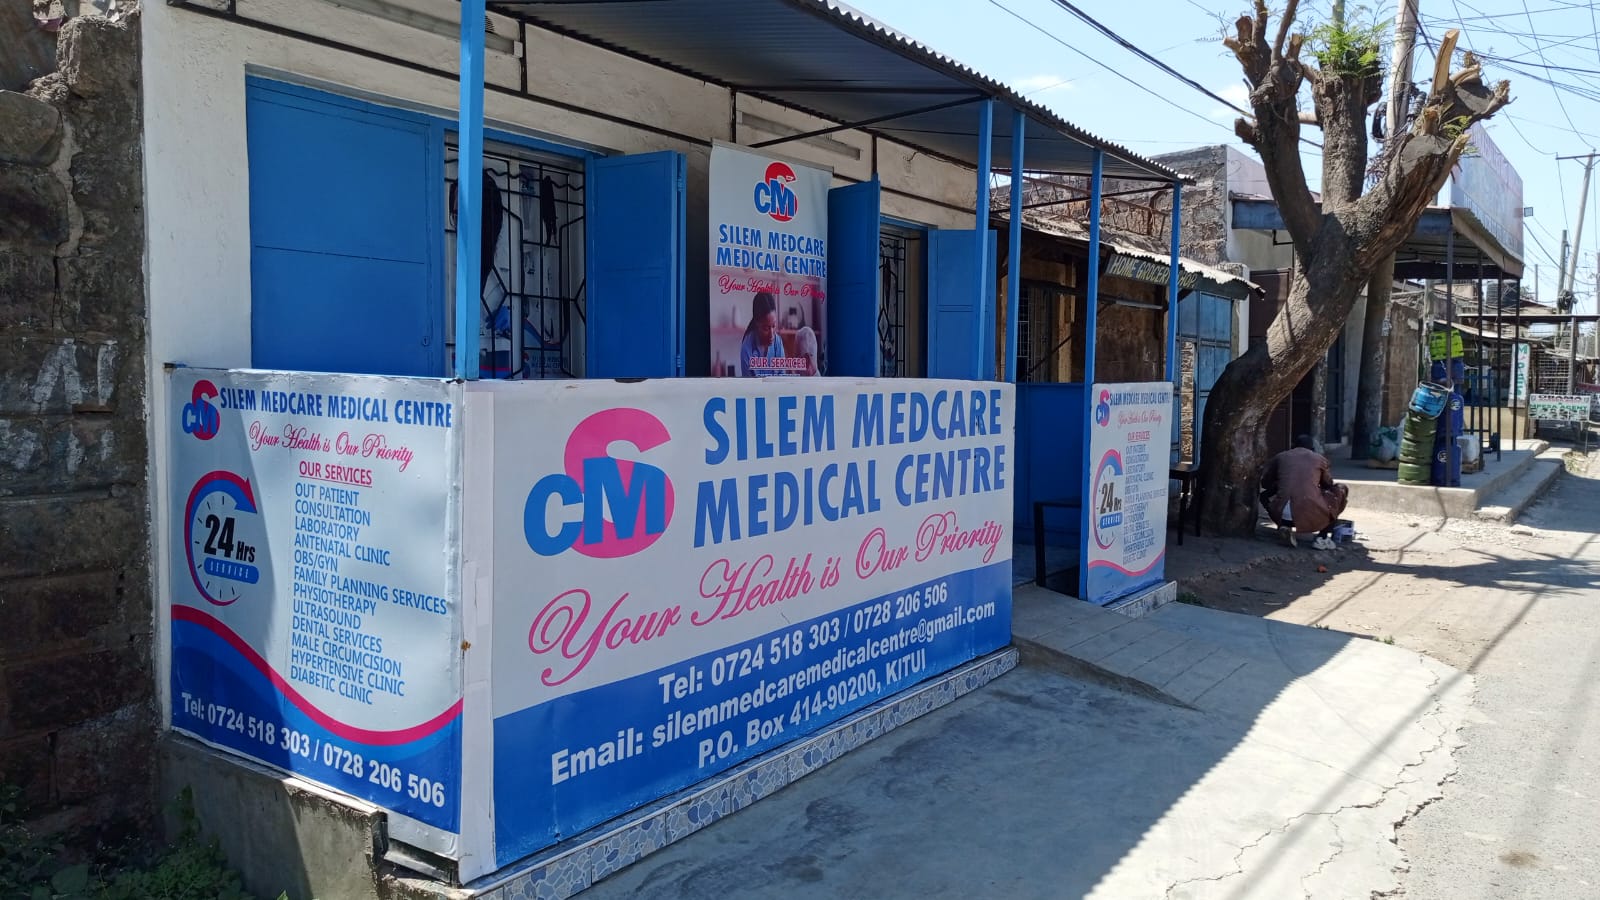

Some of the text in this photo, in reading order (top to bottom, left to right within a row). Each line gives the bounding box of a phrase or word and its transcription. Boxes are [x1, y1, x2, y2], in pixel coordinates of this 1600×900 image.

[719, 224, 824, 258] SILEM MEDCARE
[716, 246, 826, 278] MEDICAL CENTRE
[1109, 256, 1138, 277] HOME
[1178, 272, 1197, 288] HOP
[719, 274, 745, 294] Your
[784, 282, 798, 296] Our
[750, 357, 768, 369] OUR
[220, 388, 452, 428] SILEM MEDCARE MEDICAL CENTRE
[703, 389, 1002, 465] SILEM MEDCARE
[250, 420, 414, 472] Your Health is Our Priority
[300, 460, 372, 485] OUR SERVICES
[295, 482, 360, 506] OUT PATIENT
[295, 500, 371, 526] CONSULTATION
[694, 444, 1006, 548] MEDICAL CENTRE
[1101, 482, 1114, 514] 24
[204, 514, 256, 562] 24 Hrs
[295, 516, 360, 542] LABORATORY
[294, 533, 390, 566] ANTENATAL CLINIC
[294, 550, 338, 572] OBS/GYN
[294, 566, 447, 615] FAMILY PLANNING SERVICES
[294, 582, 376, 616] PHYSIOTHERAPY
[528, 511, 1003, 686] Your Health is Our Priority
[293, 599, 361, 630] ULTRASOUND
[292, 616, 382, 654] DENTAL SERVICES
[658, 582, 948, 704] Tel: 0724 518 303 / 0728 206 506
[292, 632, 402, 678] MALE CIRCUMCISION
[292, 648, 406, 696] HYPERTENSIVE CLINIC
[290, 666, 373, 705] DIABETIC CLINIC
[552, 600, 995, 786] Email: silemmedcaremedicalcentre@gmail.com
[698, 648, 926, 769] P.O. Box 414-90200, KITUI
[182, 692, 444, 807] Tel: 0724 518 303 / 0728 206 506
